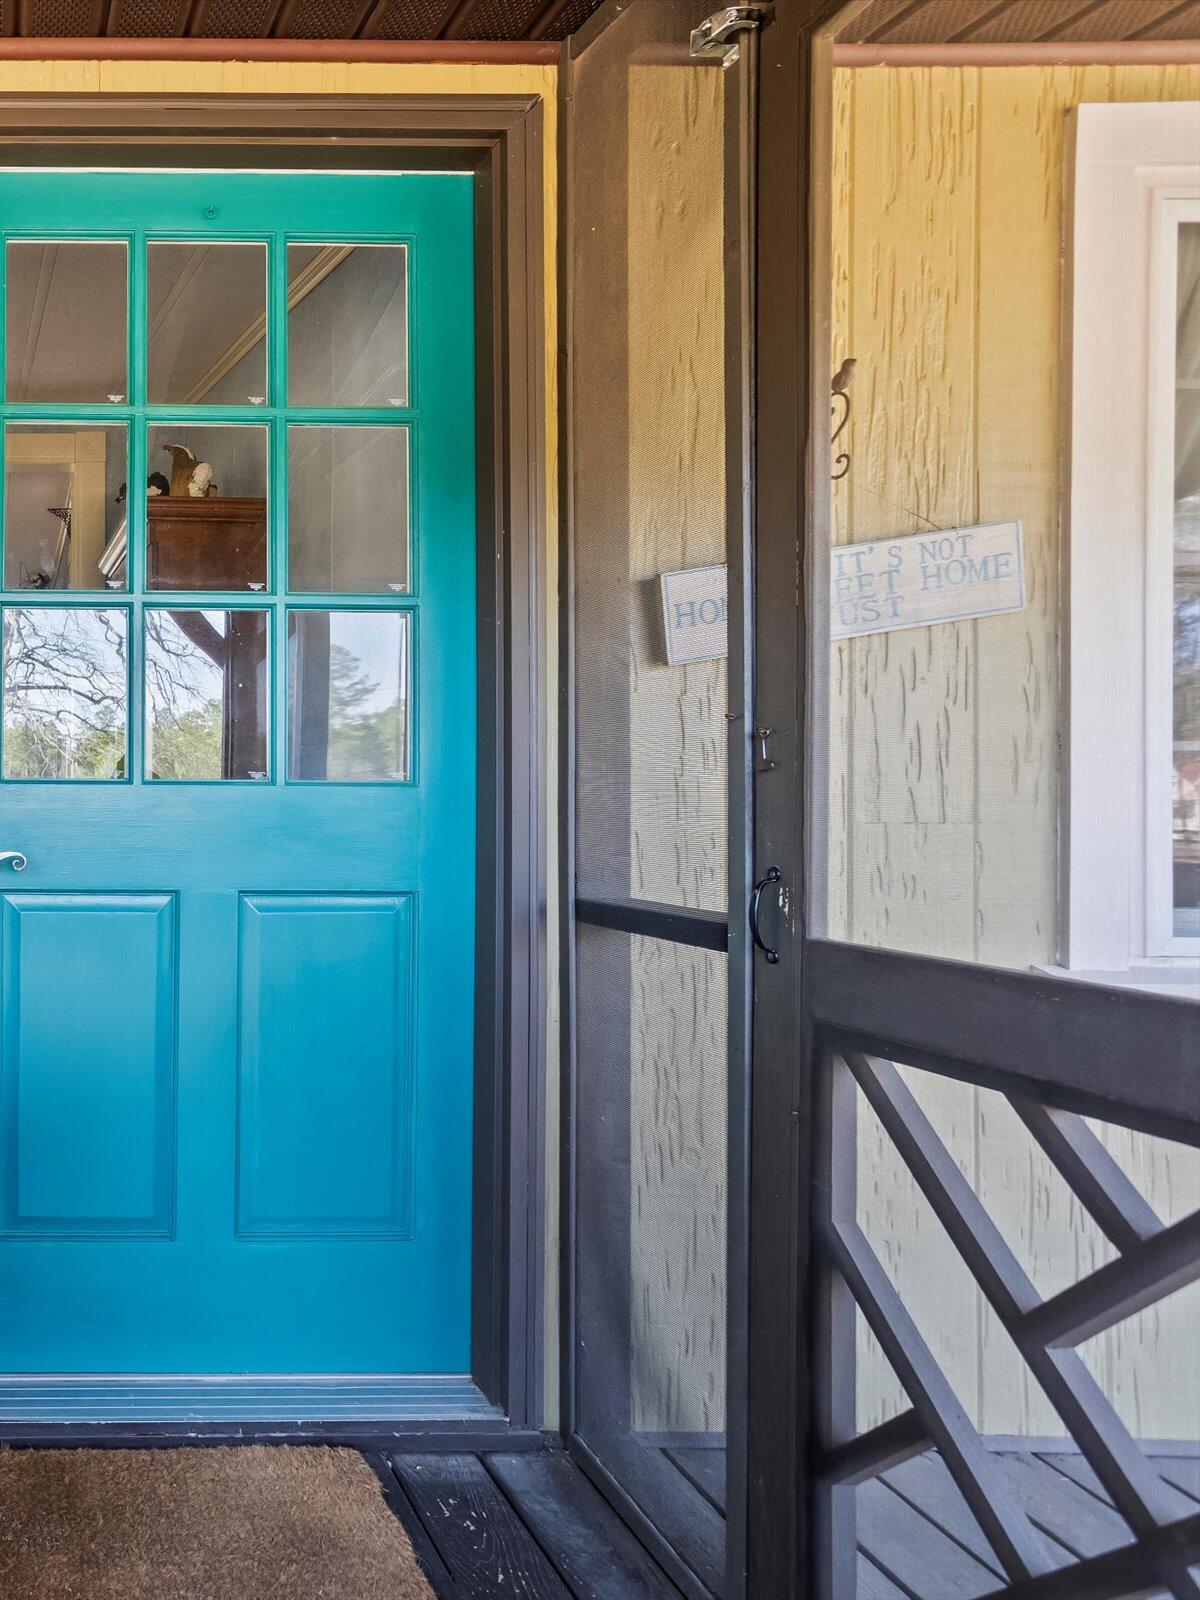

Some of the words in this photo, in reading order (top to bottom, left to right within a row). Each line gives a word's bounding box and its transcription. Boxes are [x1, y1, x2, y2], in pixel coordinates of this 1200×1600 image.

[919, 534, 973, 564] NOT
[674, 596, 728, 629] HO
[920, 552, 1012, 592] HOME
